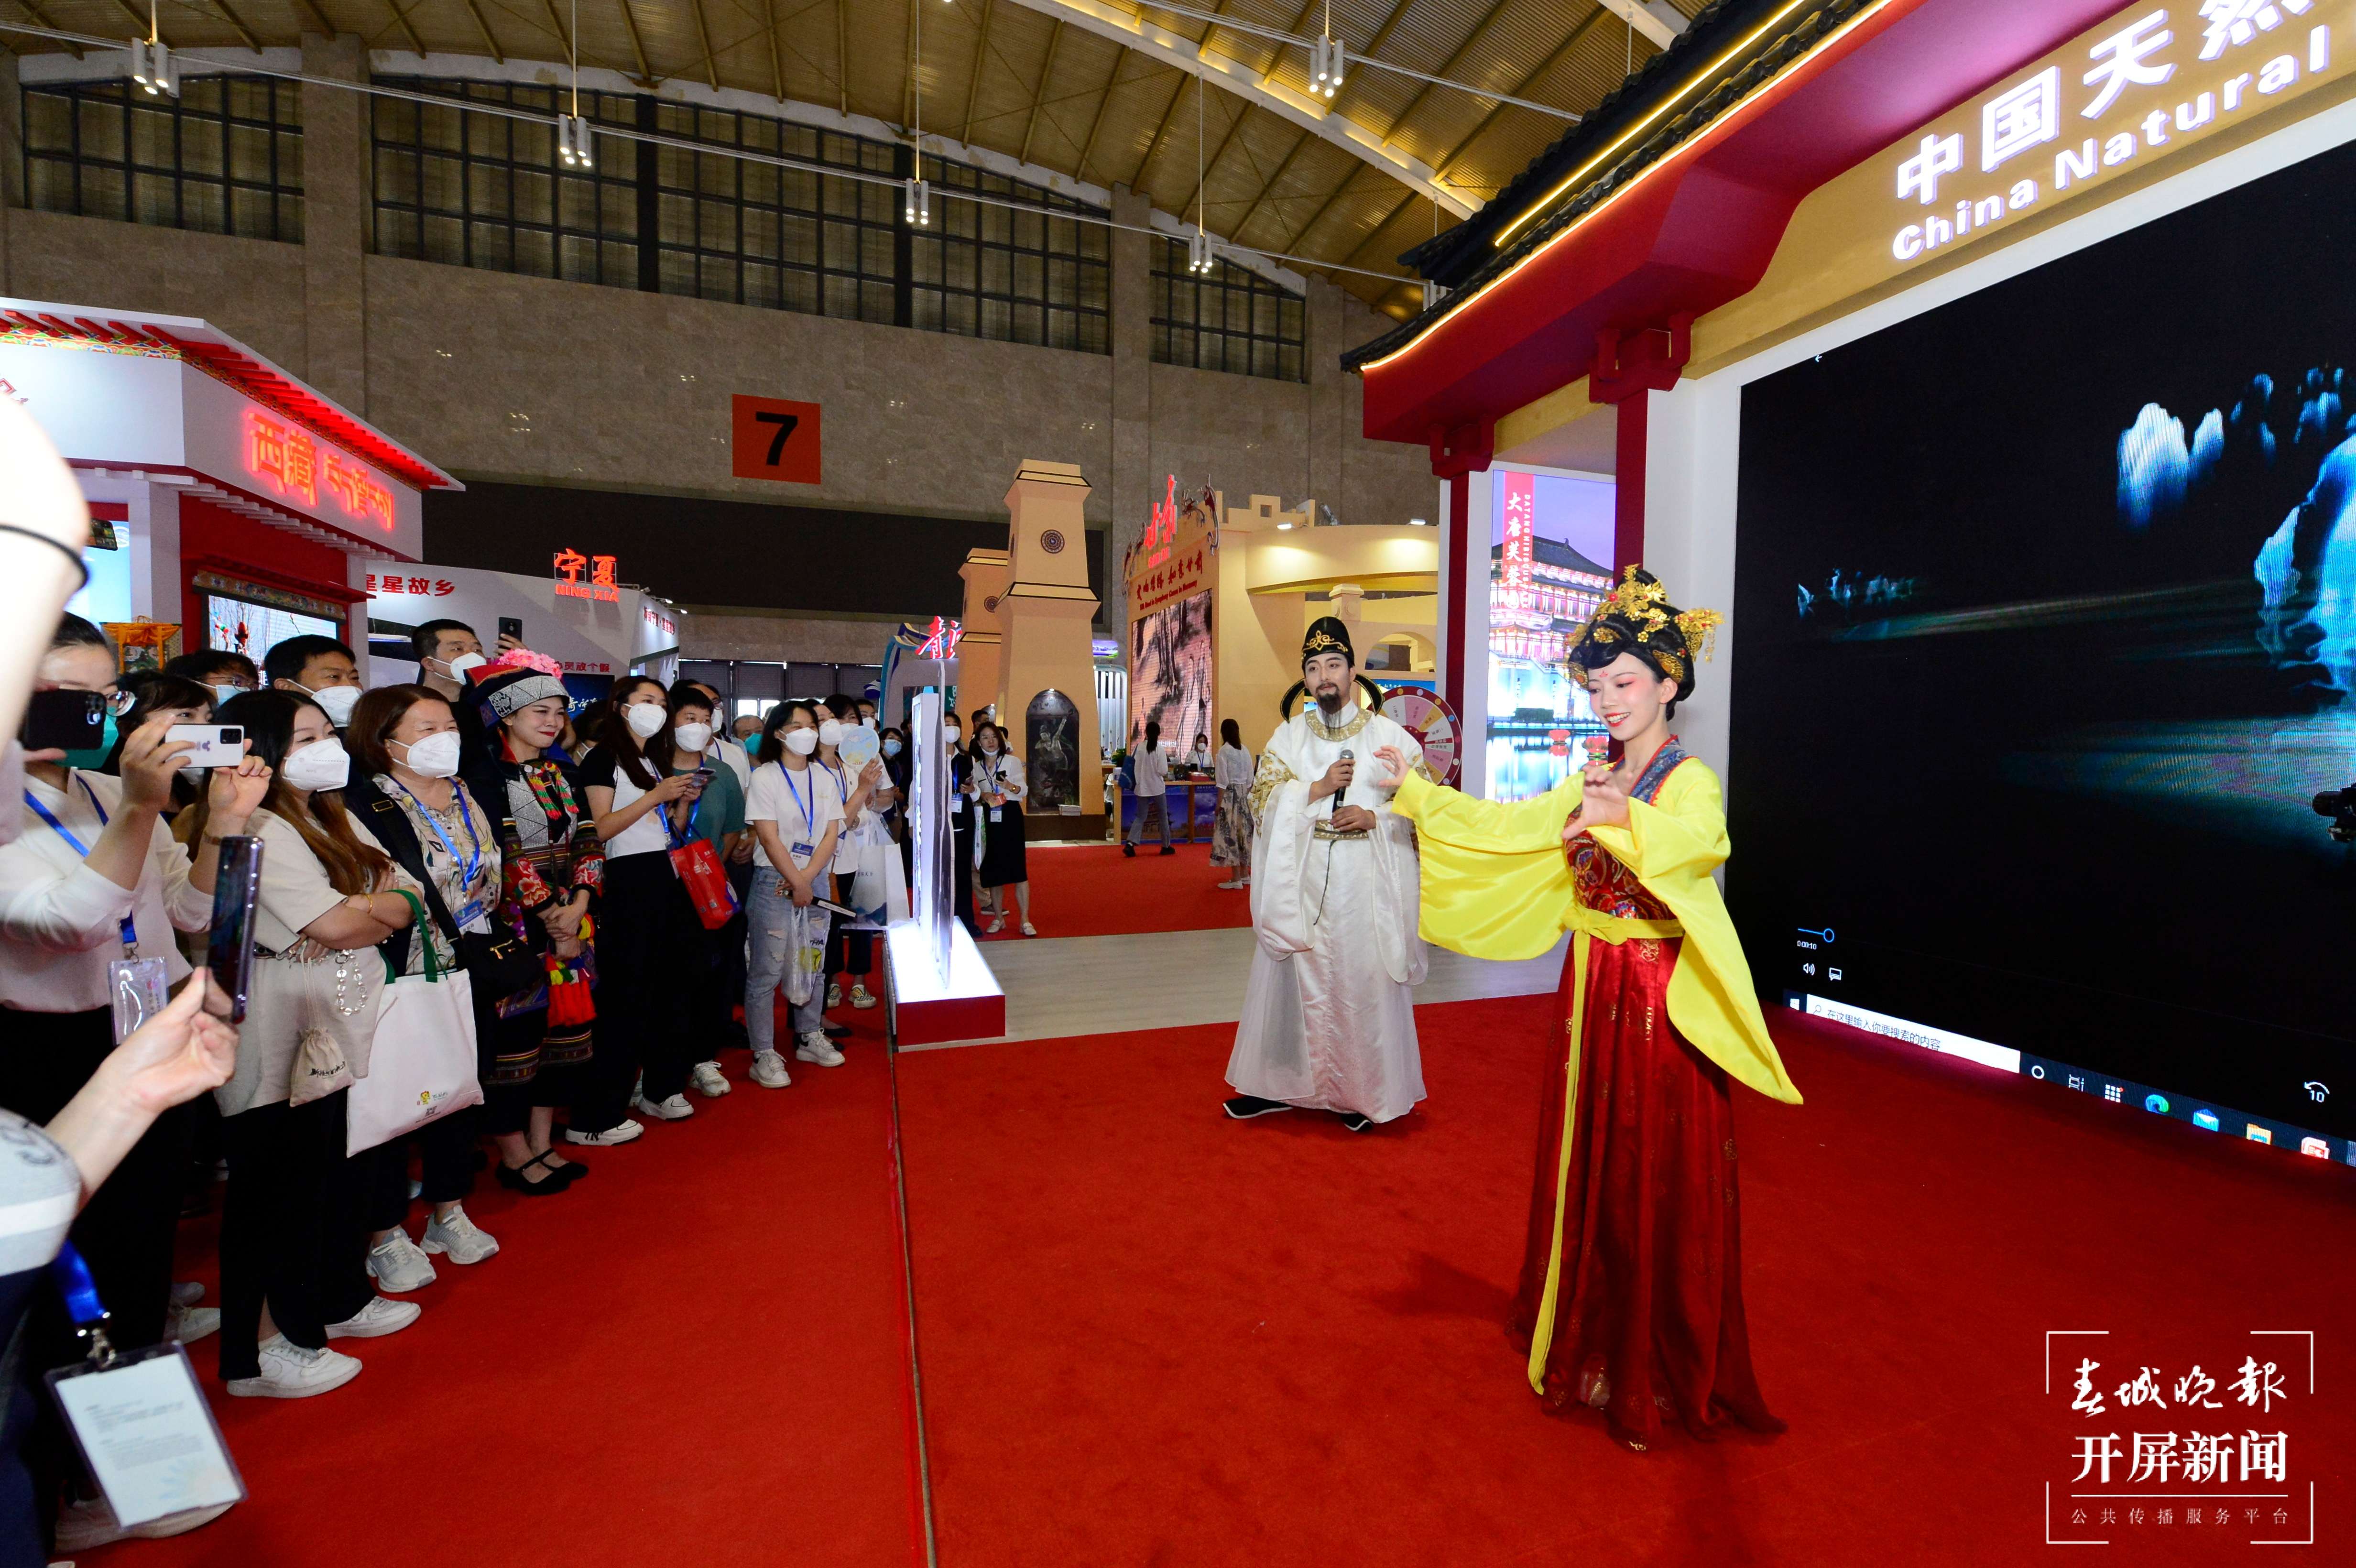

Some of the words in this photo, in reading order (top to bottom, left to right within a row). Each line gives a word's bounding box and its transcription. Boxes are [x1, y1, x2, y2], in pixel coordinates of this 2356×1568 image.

[1893, 177, 2039, 261] China
[2055, 24, 2330, 190] Natural
[248, 412, 317, 505] 西藏
[755, 412, 798, 466] 7
[554, 548, 620, 593] 宁夏
[556, 584, 590, 599] NING
[594, 589, 620, 603] XIA
[1827, 1009, 1941, 1051] 在这里输入你要搜索的内容
[2309, 1090, 2325, 1103] 10
